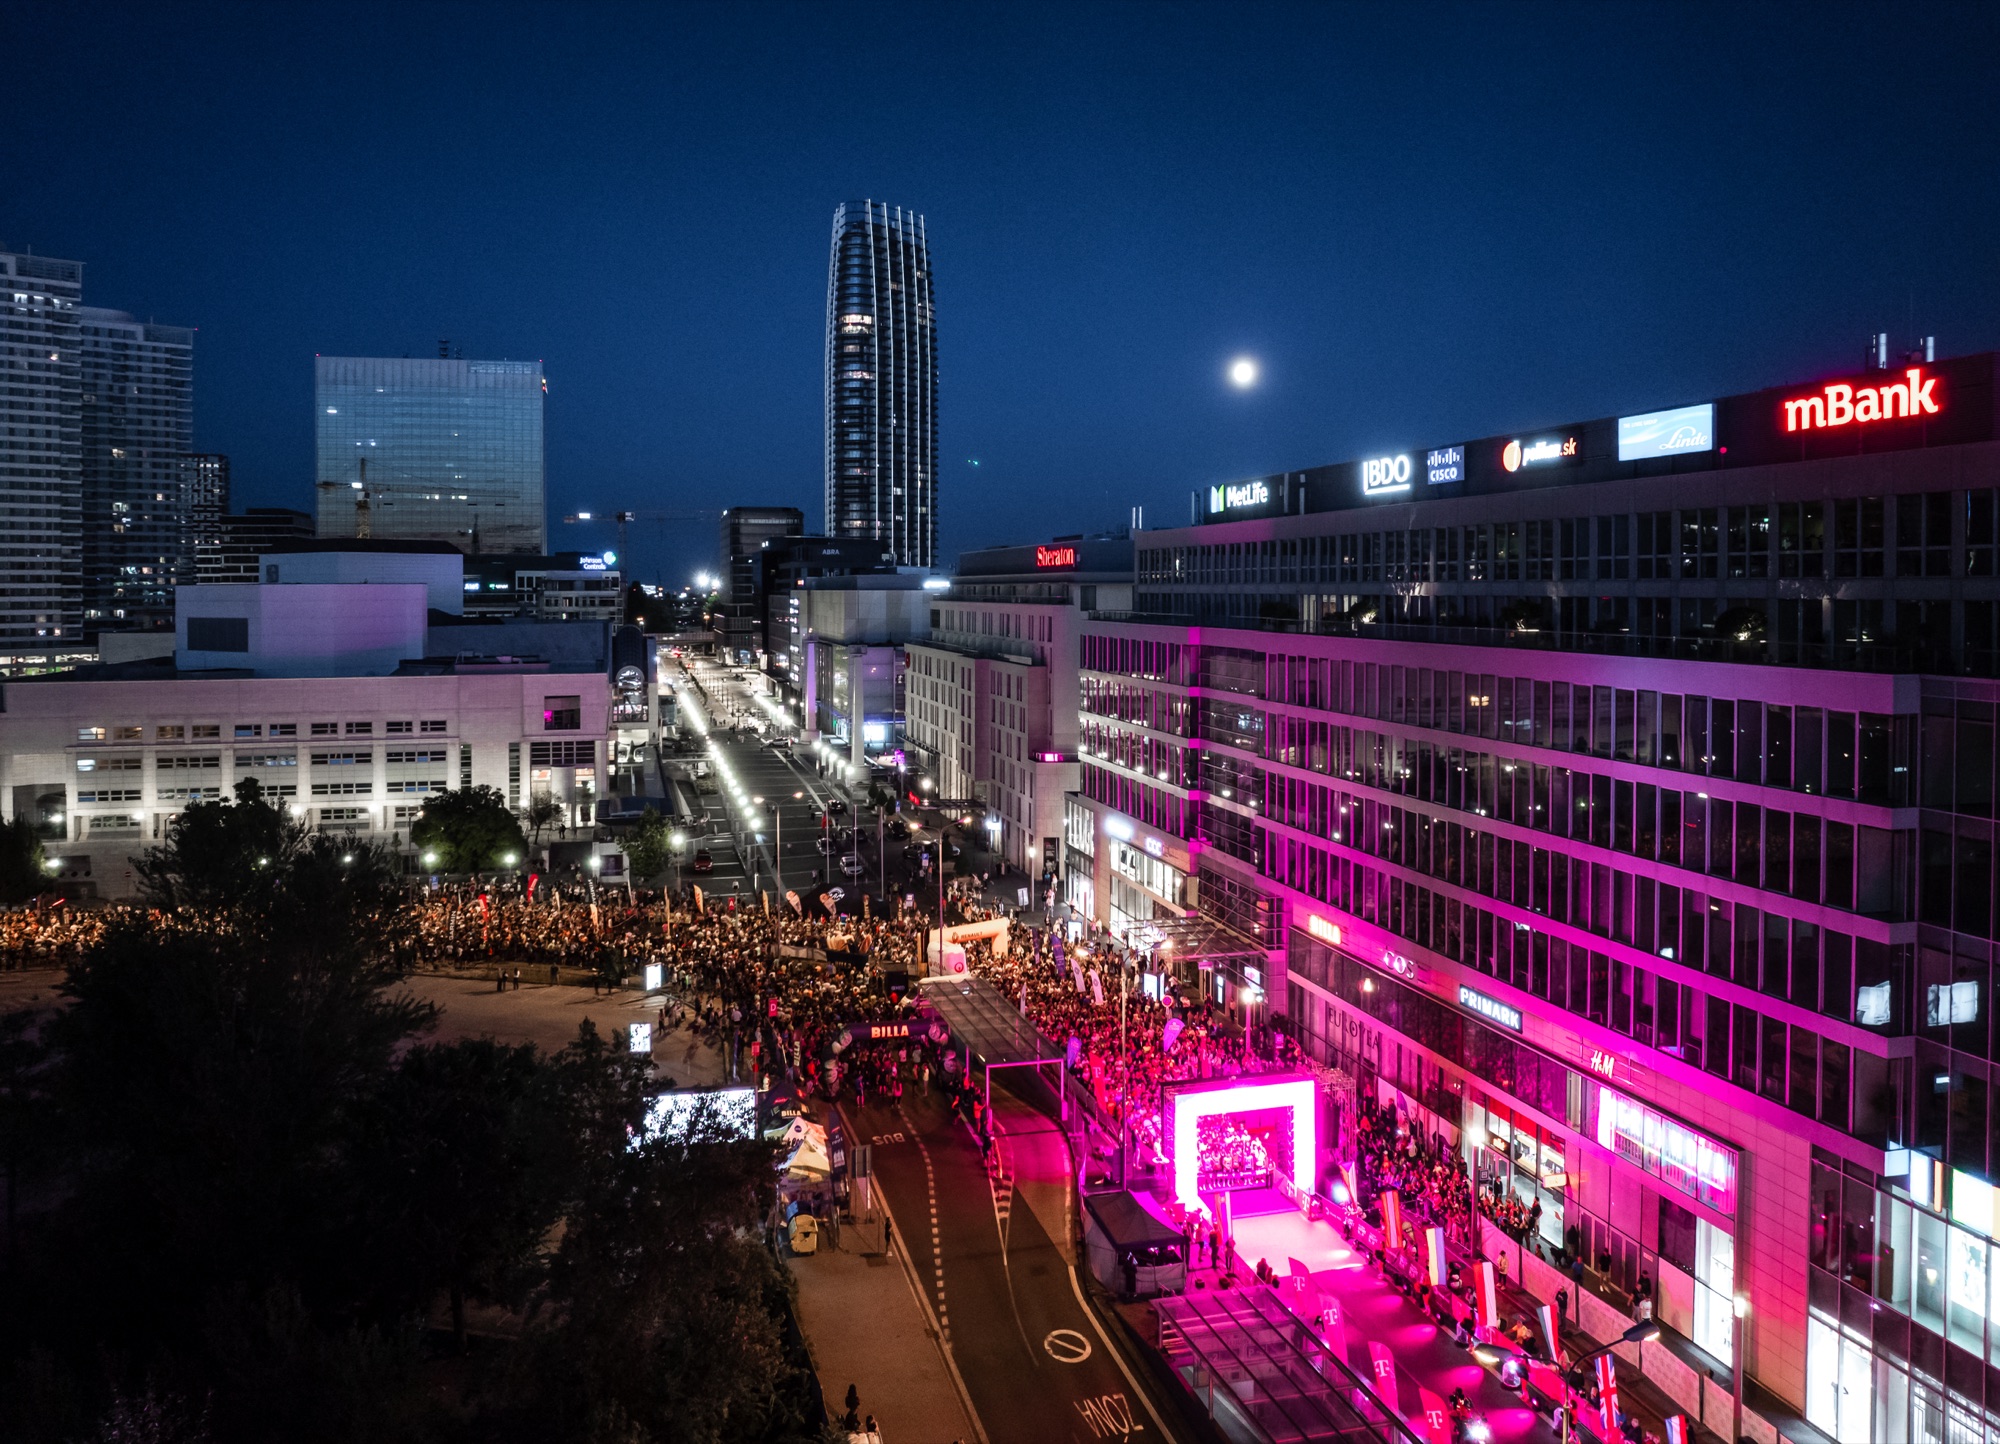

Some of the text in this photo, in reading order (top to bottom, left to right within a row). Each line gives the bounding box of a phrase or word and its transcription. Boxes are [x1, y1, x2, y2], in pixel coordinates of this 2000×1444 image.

[1785, 368, 1939, 432] mBank
[1659, 425, 1708, 450] Linde
[1368, 454, 1411, 487] BDO
[1226, 482, 1269, 508] MetLife
[1037, 546, 1074, 567] Sheraton
[1384, 950, 1415, 979] COS
[770, 1003, 777, 1012] D
[1460, 987, 1520, 1030] PRIMARK
[871, 1025, 909, 1039] BILLA
[1590, 1049, 1615, 1079] H&M
[781, 1109, 802, 1117] BILLA
[872, 1132, 906, 1146] BUS
